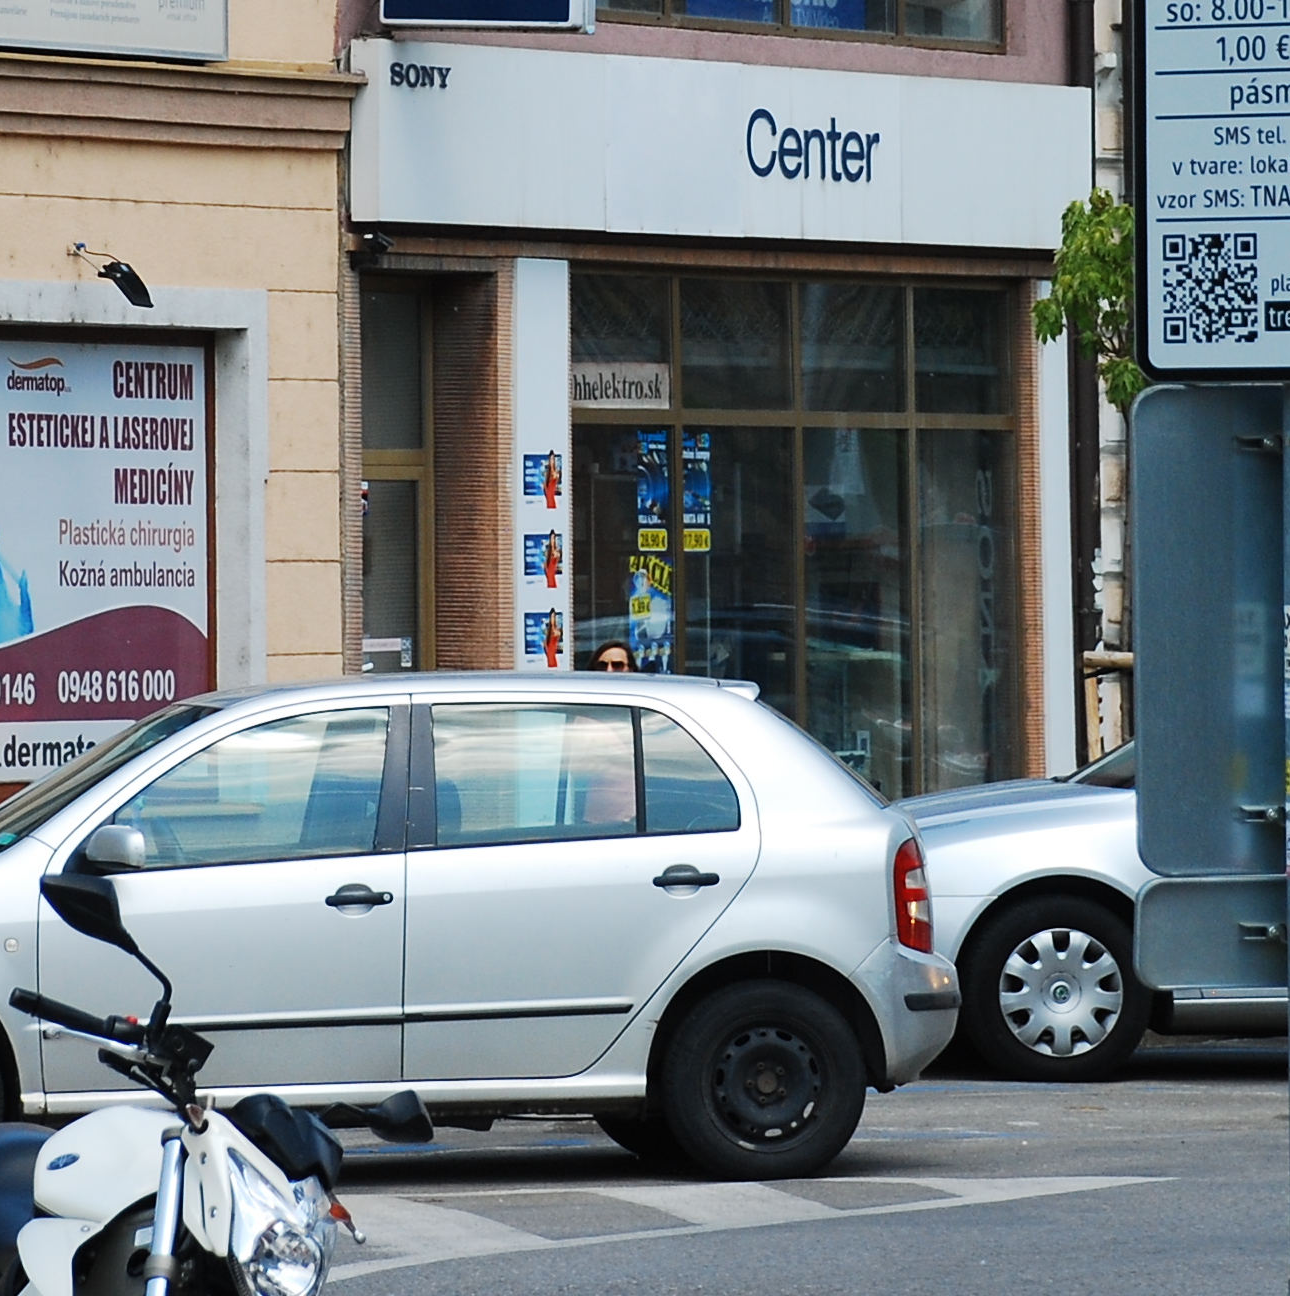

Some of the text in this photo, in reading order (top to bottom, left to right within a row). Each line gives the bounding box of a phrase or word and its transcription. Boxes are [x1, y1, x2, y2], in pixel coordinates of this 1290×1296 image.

[1166, 2, 1201, 22] so:
[1216, 35, 1266, 66] 1,00
[389, 62, 452, 90] SONY
[746, 108, 880, 183] Center
[1213, 126, 1250, 145] SMS
[1256, 125, 1286, 144] tel.
[1172, 161, 1183, 175] v
[1190, 158, 1243, 175] tvare:
[1157, 194, 1196, 209] vzor
[1203, 188, 1245, 208] SMS:
[7, 369, 66, 396] dermatop
[112, 360, 194, 401] CENTRUM
[573, 372, 663, 401] hhelektro.sk
[8, 412, 194, 451] ESTETICKEJ A LASEROVEJ
[114, 462, 195, 506] MEDICÍNY
[58, 518, 195, 553] Plastická chirurgia
[58, 559, 196, 588] Kožná ambulancia
[58, 671, 104, 703] 0948
[106, 670, 142, 702] 616
[142, 669, 176, 702] 000
